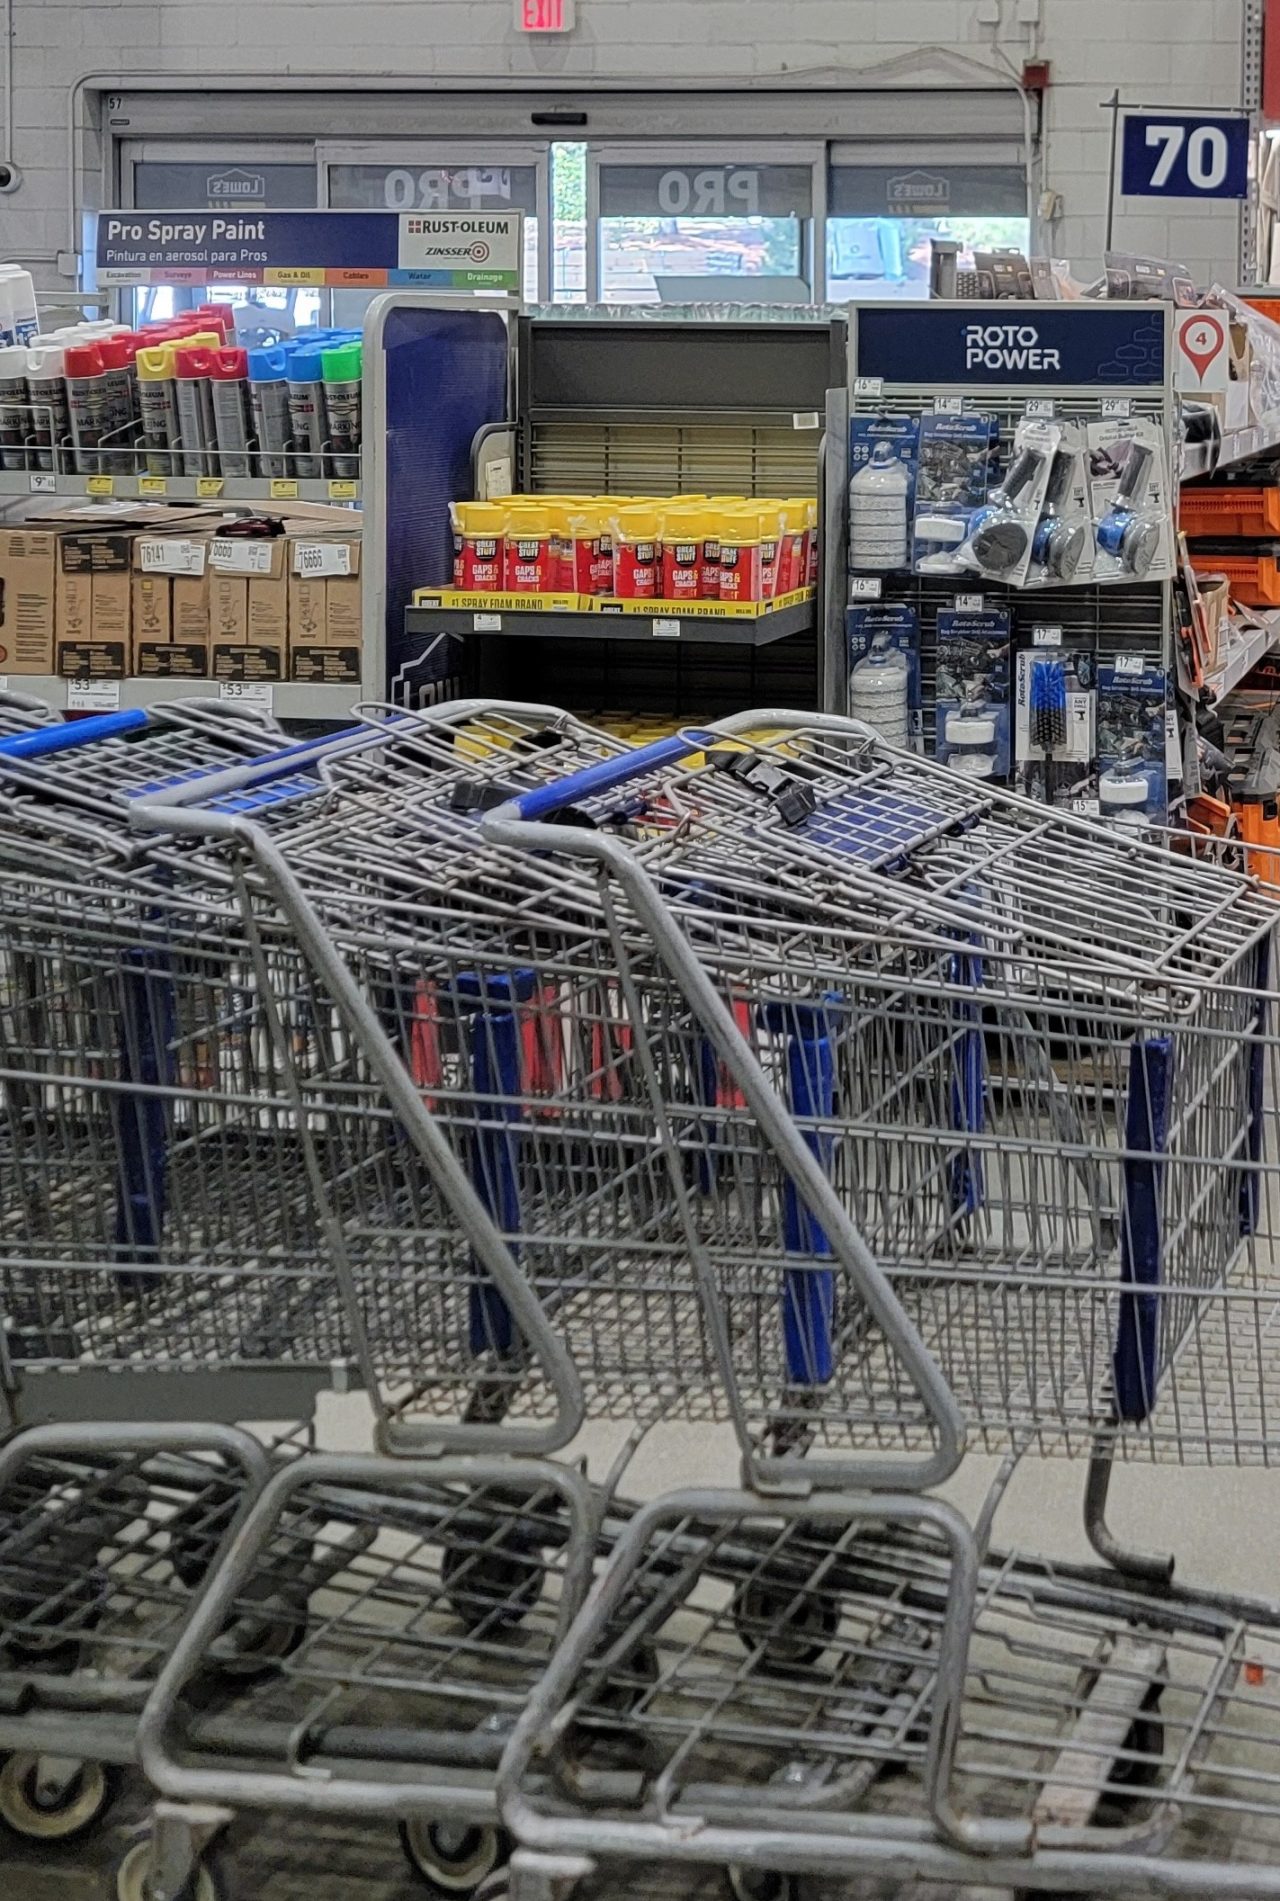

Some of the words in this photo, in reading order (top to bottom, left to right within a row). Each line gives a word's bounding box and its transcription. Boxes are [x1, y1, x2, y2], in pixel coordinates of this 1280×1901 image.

[522, 0, 563, 28] EXIT
[109, 97, 122, 110] 57
[1145, 125, 1227, 189] 70
[108, 221, 142, 240] Pro
[148, 220, 206, 244] Spray
[212, 219, 265, 240] Paint
[423, 220, 509, 234] RUST-OLEUM
[106, 250, 146, 262] Pintura
[149, 253, 162, 261] en
[165, 250, 208, 262] aerosol
[211, 252, 236, 263] para
[240, 249, 267, 261] Pros
[425, 247, 471, 256] ZINSSER
[213, 271, 235, 279] Power
[277, 271, 291, 279] Gas
[467, 272, 503, 281] Drainage
[966, 325, 1038, 347] ROTO
[1195, 332, 1207, 346] 4
[966, 349, 1060, 370] POWER
[1028, 400, 1039, 411] 29
[1105, 400, 1116, 411] 29
[476, 547, 496, 557] STUFF
[472, 564, 493, 575] GAPS
[515, 566, 535, 576] GAPS
[673, 570, 692, 581] GAPS
[461, 598, 488, 609] SPRAY
[490, 599, 513, 609] FOAM
[515, 599, 543, 610] BRAND
[952, 619, 995, 628] RotoScrub
[1017, 654, 1026, 707] RotoScrub
[1112, 676, 1153, 685] RotoScrub
